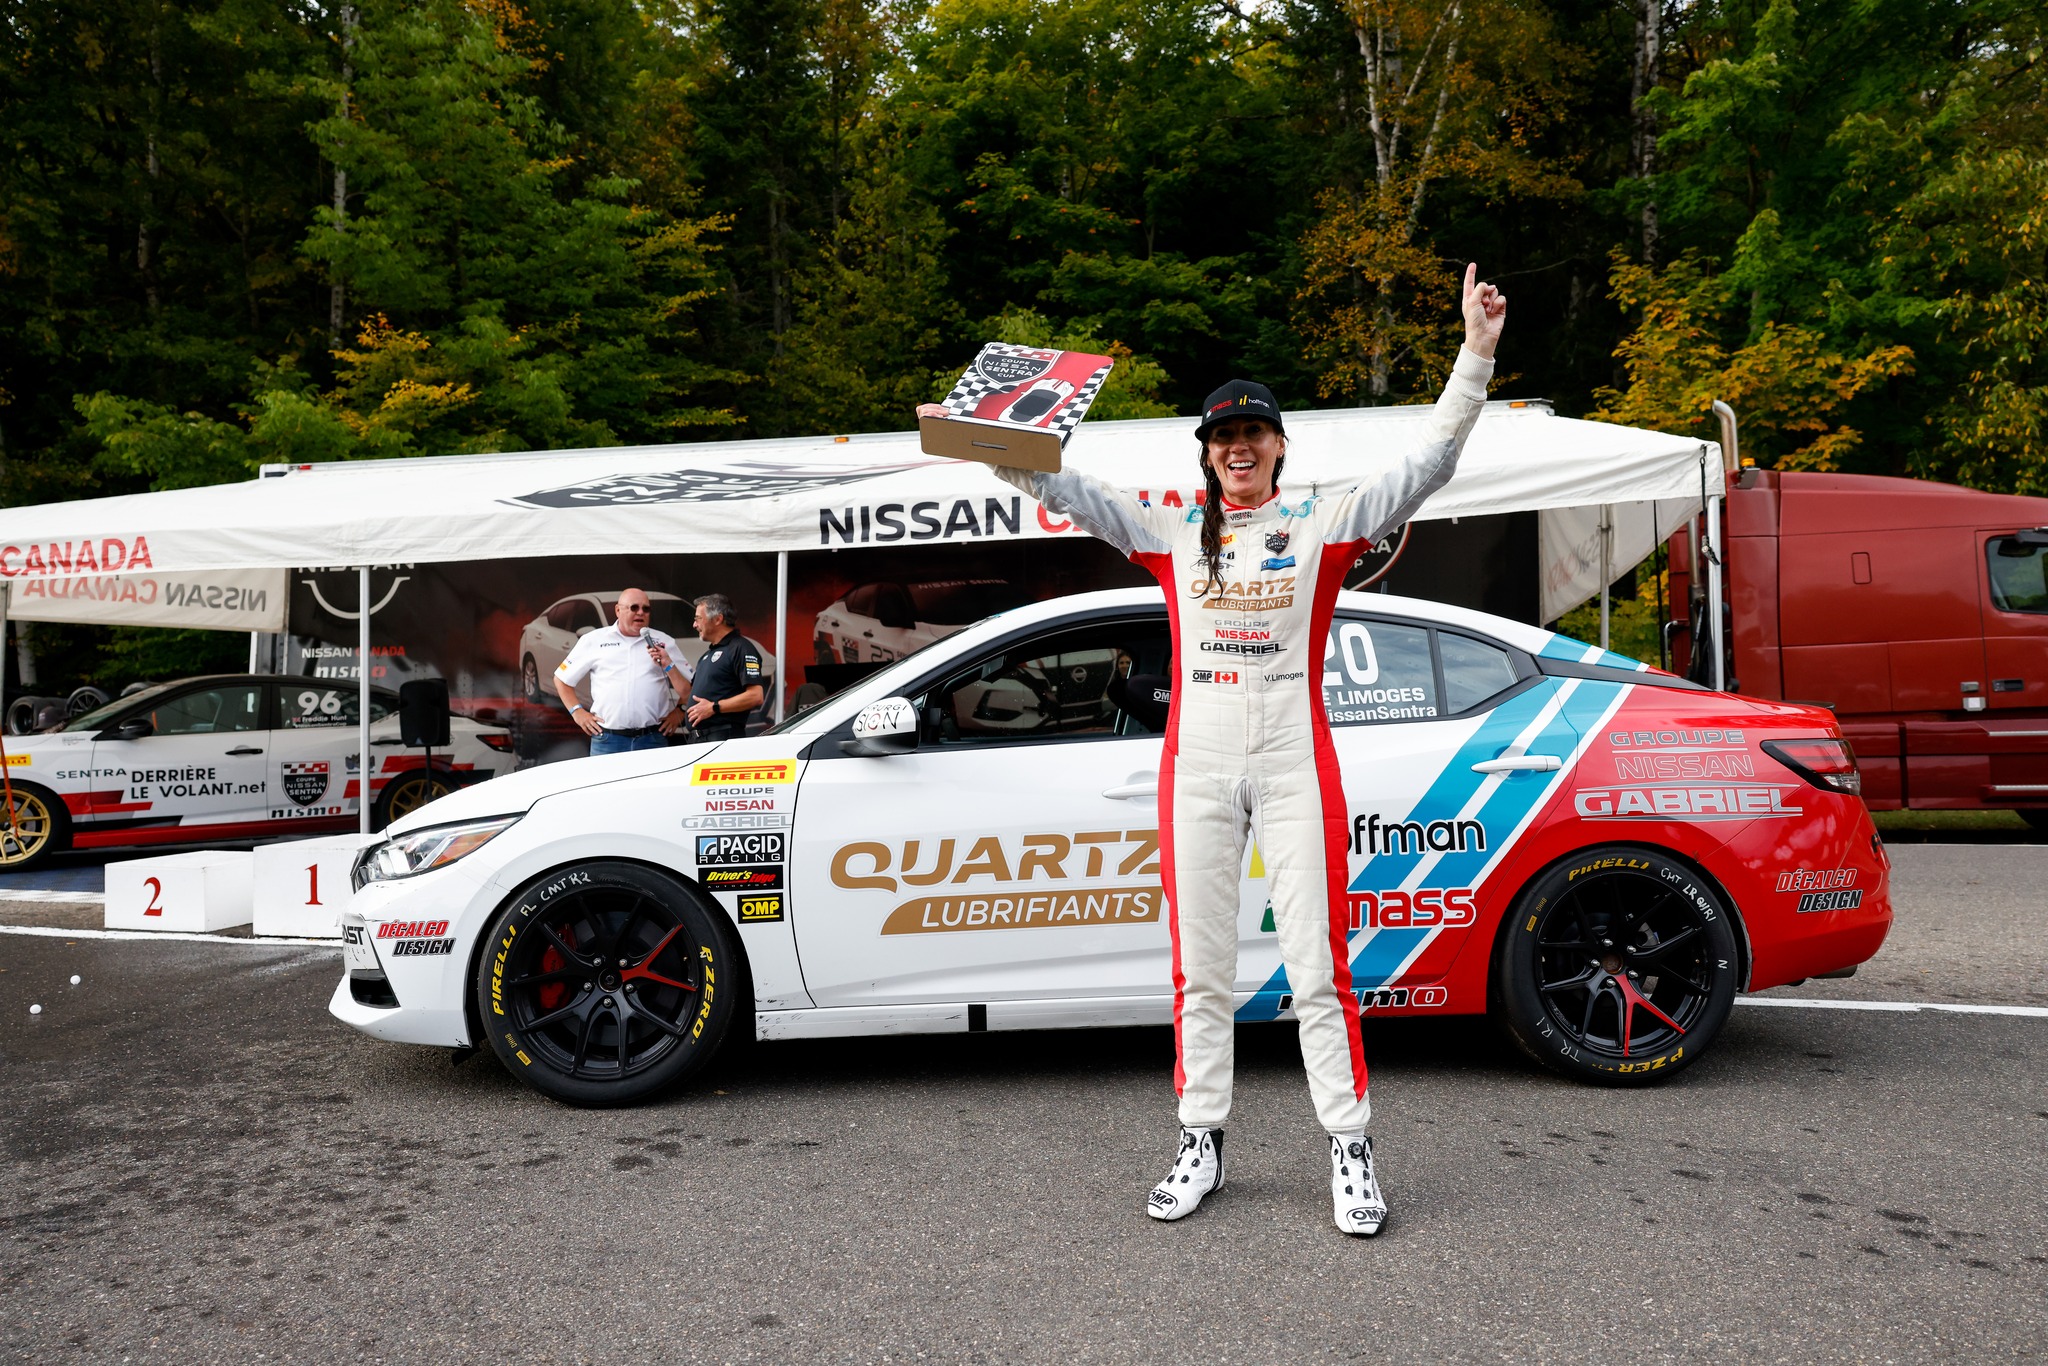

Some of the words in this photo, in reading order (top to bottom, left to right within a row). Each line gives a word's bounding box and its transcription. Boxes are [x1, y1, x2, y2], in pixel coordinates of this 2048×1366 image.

[984, 360, 1041, 372] NISSAN
[1002, 358, 1030, 366] COUPE
[985, 366, 1033, 376] SENTRA
[819, 496, 1021, 545] NISSAN
[0, 536, 153, 577] CANADA
[918, 580, 966, 589] NISSAN
[1190, 576, 1295, 596] QUARTZ
[1214, 597, 1290, 610] LUBRIFIANTS
[1214, 619, 1270, 628] GROUPE
[1215, 629, 1270, 640] NISSAN
[301, 647, 352, 658] NISSAN
[1200, 642, 1287, 654] GABRIEL
[1192, 672, 1212, 680] OMP
[1264, 671, 1304, 682] V.Limoges
[297, 690, 341, 715] 96
[1153, 690, 1170, 701] OM
[1337, 687, 1425, 706] LIMOGES
[1609, 730, 1746, 746] GROUPE
[56, 768, 127, 779] SENTRA
[131, 765, 217, 783] DERRIÈRE
[699, 764, 787, 781] PIRELLI
[1615, 754, 1754, 779] NISSAN
[130, 786, 149, 800] LE
[159, 781, 266, 798] VOLANT.net
[289, 788, 322, 796] SENTRA
[706, 787, 774, 795] GROUPE
[705, 800, 774, 811] NISSAN
[1574, 789, 1803, 816] GABRIEL
[271, 806, 341, 818] nismo
[681, 815, 792, 828] GABRIEL
[1348, 813, 1485, 856] ffman
[720, 835, 781, 855] PAGID
[699, 853, 780, 864] RACING
[829, 829, 1160, 894] QUARTZ
[706, 870, 752, 881] Driver's
[750, 873, 776, 883] Edge
[1568, 857, 1649, 882] PIRELLI
[305, 863, 324, 905] 1
[1776, 868, 1858, 892] DÉCALCO
[143, 876, 163, 917] 2
[1797, 890, 1863, 914] DESIGN
[520, 903, 537, 917] FL
[742, 901, 780, 916] OMP
[921, 892, 1152, 928] LUBRIFIANTS
[377, 919, 449, 938] DÉCALCO
[393, 939, 456, 956] DESIGN
[491, 925, 517, 1016] PIRELLI
[692, 964, 716, 1039] ZERO
[1149, 1190, 1174, 1206] OMP
